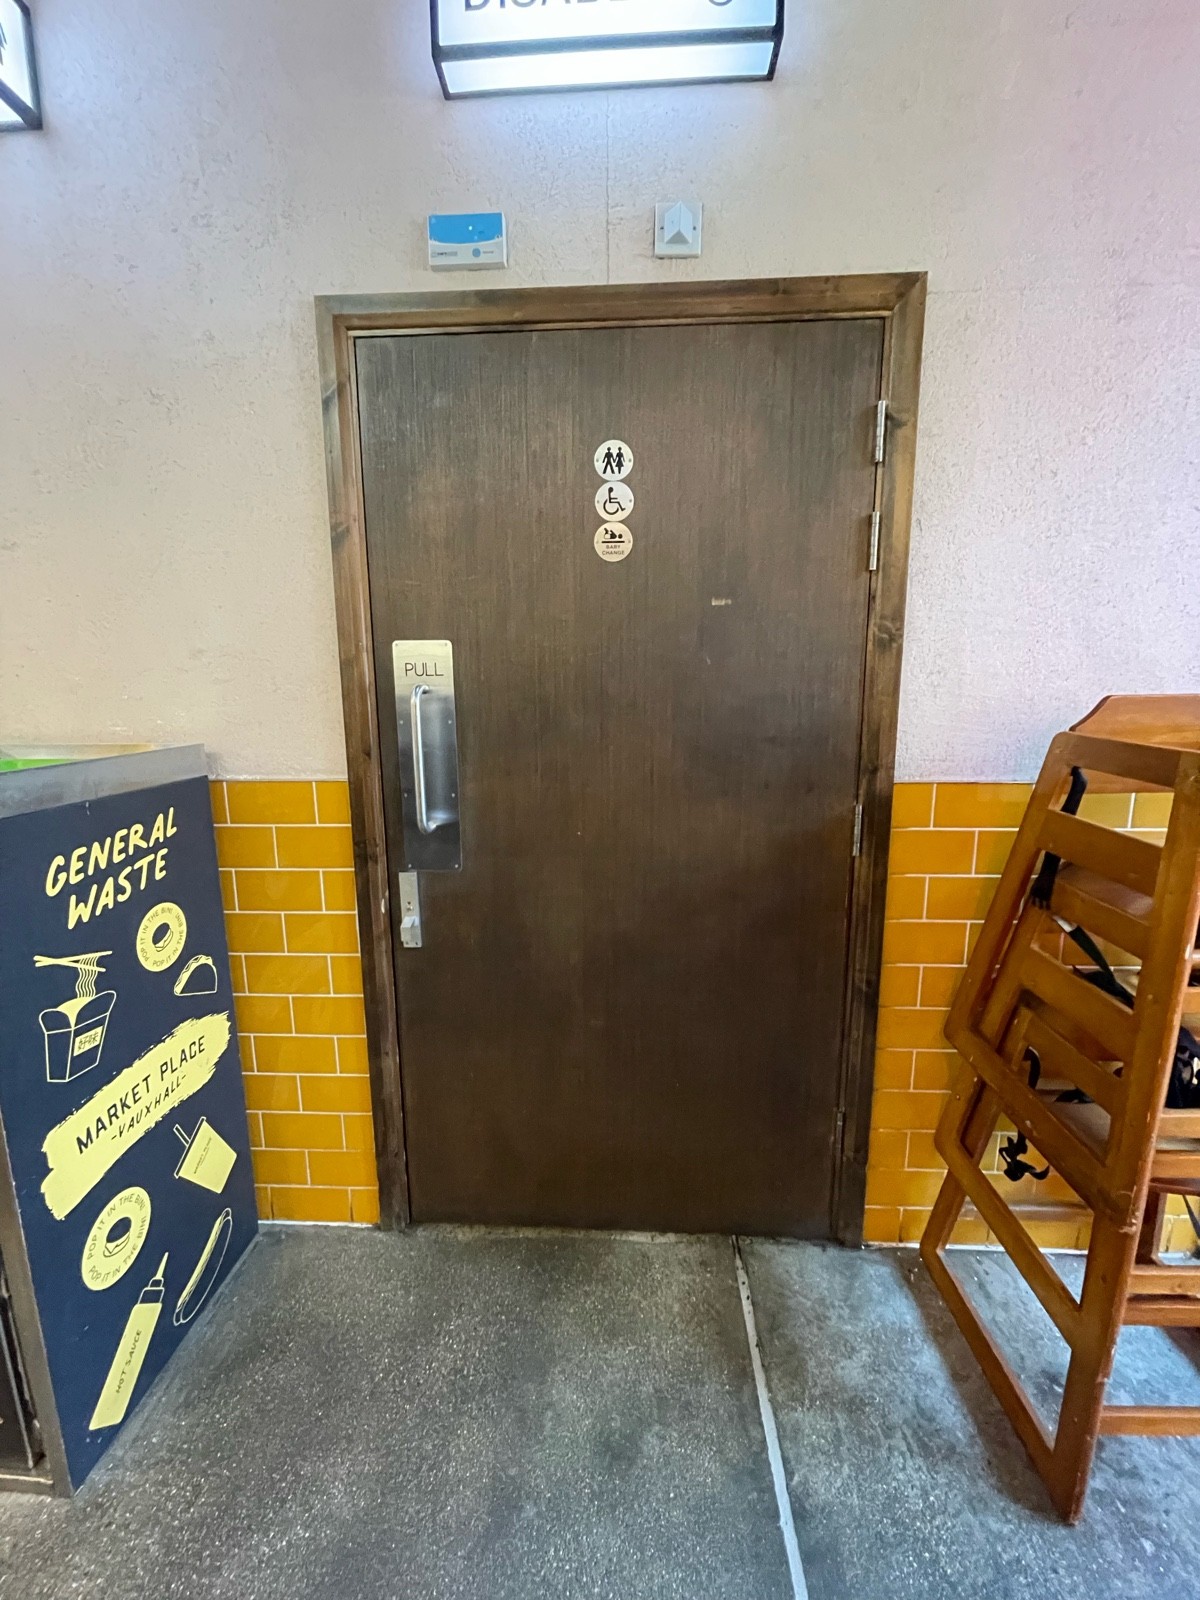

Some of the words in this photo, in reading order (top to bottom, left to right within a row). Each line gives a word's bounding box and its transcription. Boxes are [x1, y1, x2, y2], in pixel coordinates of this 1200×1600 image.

[404, 662, 445, 677] PULL
[45, 806, 178, 897] GENERAL
[67, 848, 169, 929] WASTE
[142, 925, 149, 934] IN
[147, 910, 160, 923] THE
[140, 947, 151, 962] POP
[152, 959, 165, 968] POP
[176, 930, 184, 945] THE
[75, 1073, 152, 1155] MARKET
[159, 1035, 206, 1082] PLACE
[86, 1234, 98, 1260] POP
[97, 1219, 105, 1230] IT
[107, 1204, 117, 1217] IN
[119, 1193, 135, 1206] THE
[88, 1265, 102, 1281] POP
[101, 1271, 112, 1283] IT
[111, 1265, 121, 1277] IN
[123, 1243, 139, 1265] THE
[116, 1367, 127, 1394] HOT
[125, 1329, 142, 1367] SAUCE
